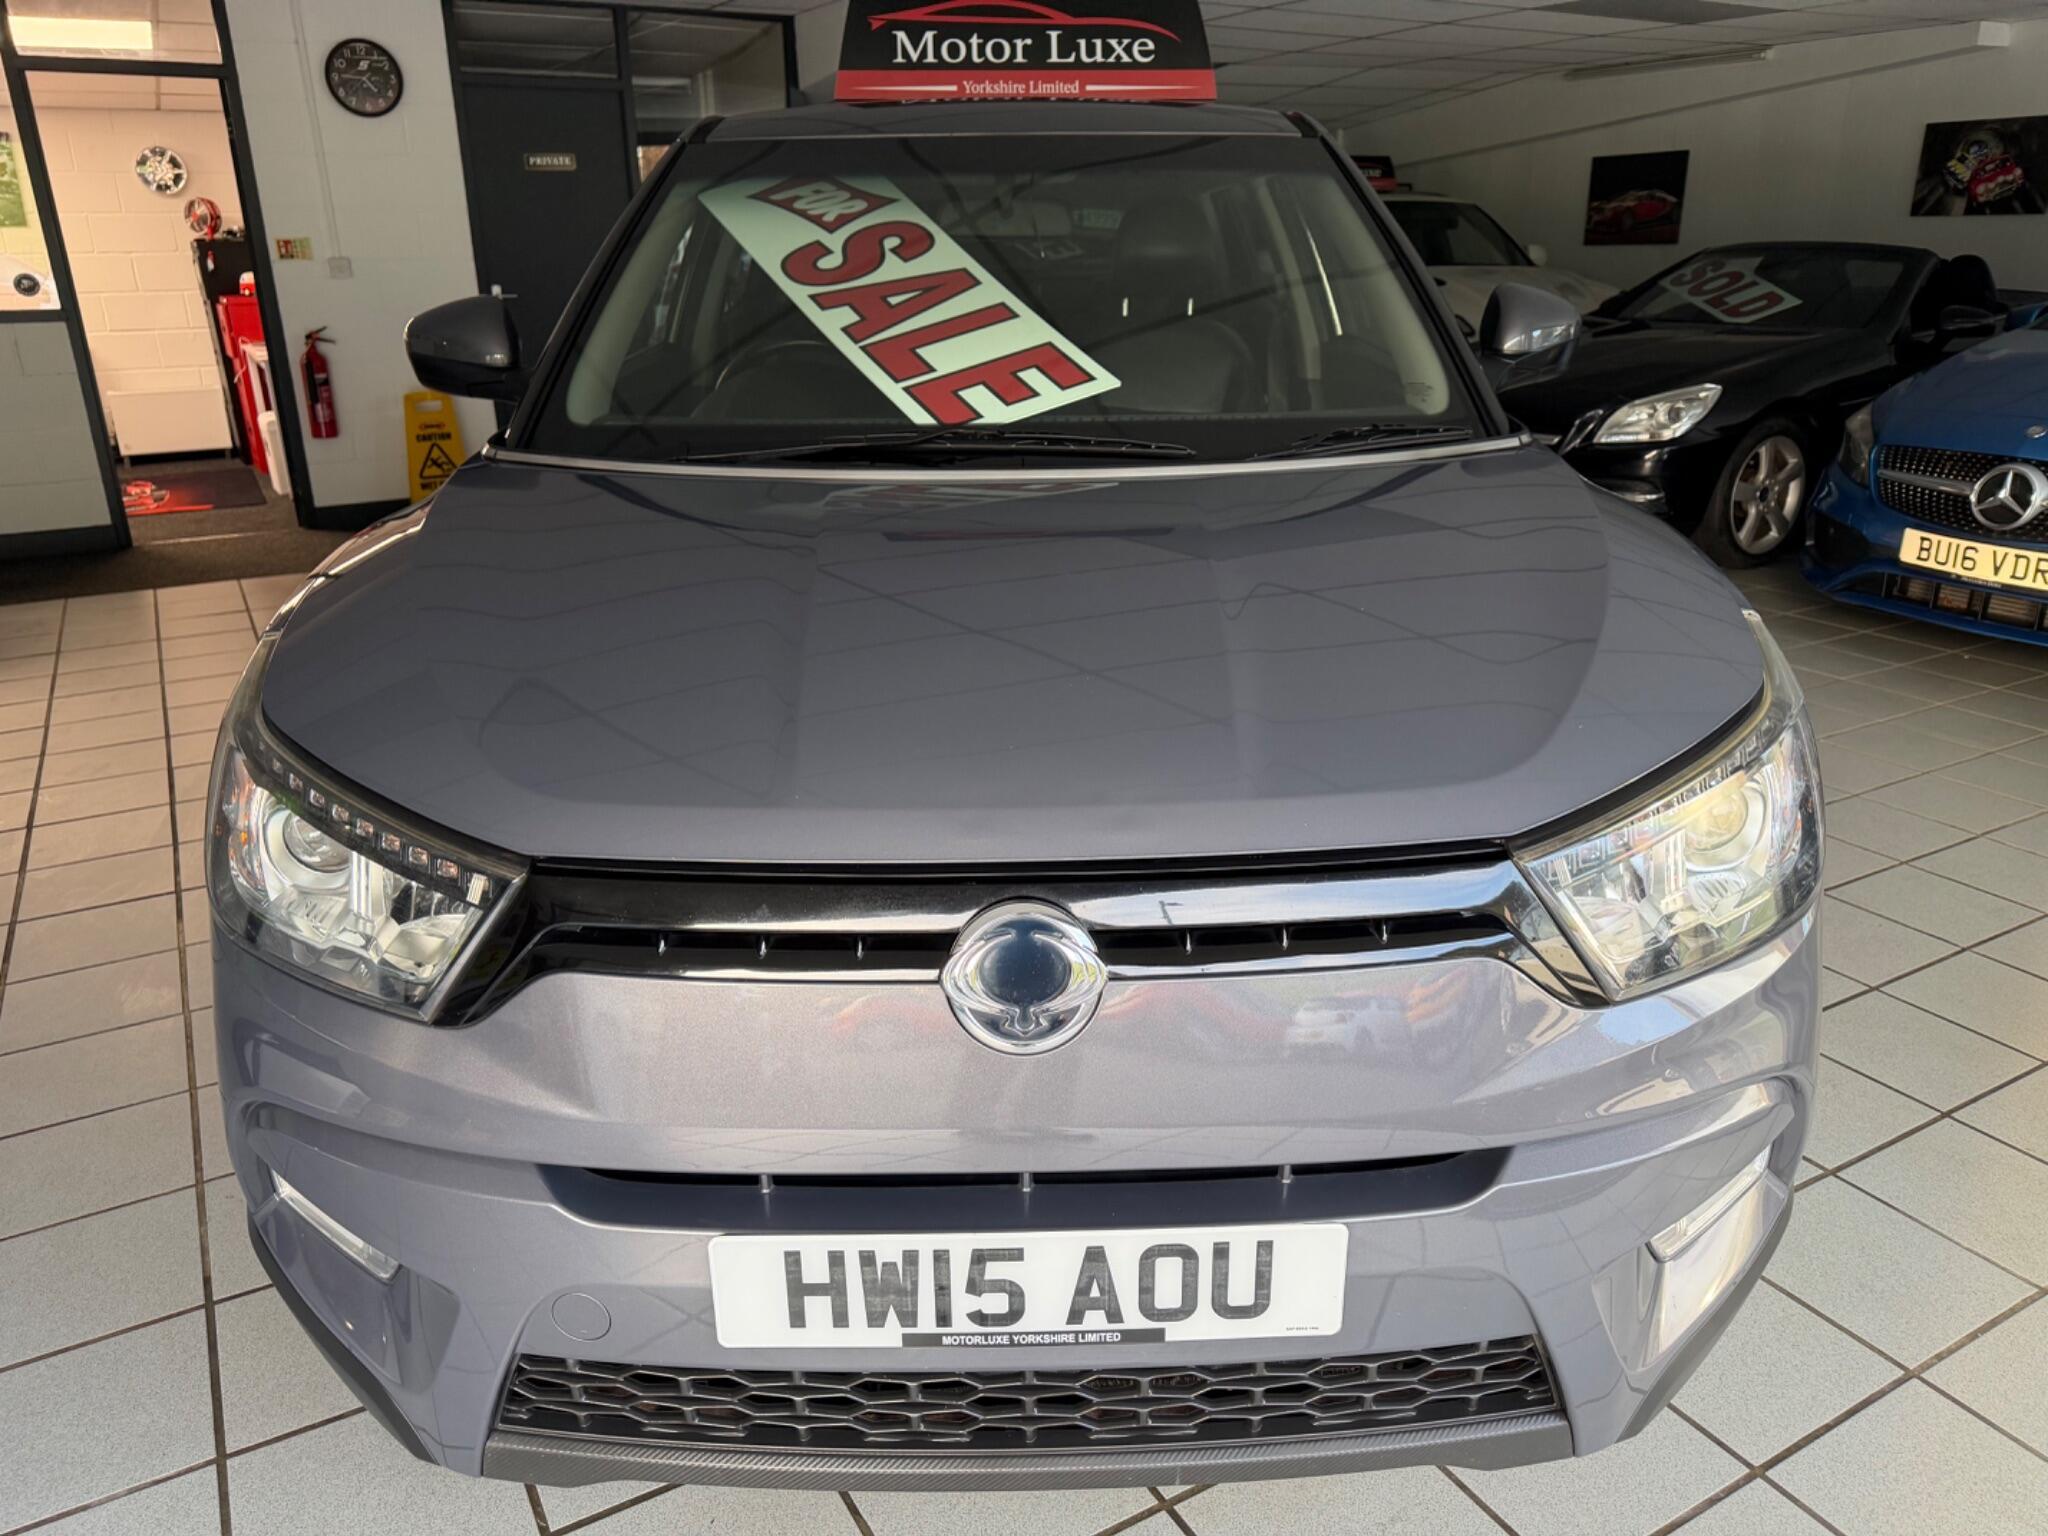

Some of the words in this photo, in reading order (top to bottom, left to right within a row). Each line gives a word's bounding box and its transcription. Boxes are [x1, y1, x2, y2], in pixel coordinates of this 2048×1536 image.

[892, 30, 1032, 63] Motor
[1046, 30, 1156, 63] Luxe
[963, 80, 1026, 95] Yorkshire
[1029, 80, 1080, 94] Limited
[529, 156, 571, 166] PRIVATE
[769, 180, 869, 223] FOR
[1669, 259, 1785, 318] SOLD
[780, 220, 1098, 426] SALE
[416, 432, 452, 442] CAUTION
[1916, 535, 1980, 572] BU16
[1992, 550, 2048, 584] VDR
[783, 1247, 1026, 1329] HW15
[1066, 1240, 1275, 1325] AOU
[942, 1335, 1010, 1346] MOTORLUXE
[1012, 1334, 1076, 1344] YORKSHIRE
[1078, 1332, 1121, 1342] LIMITED
